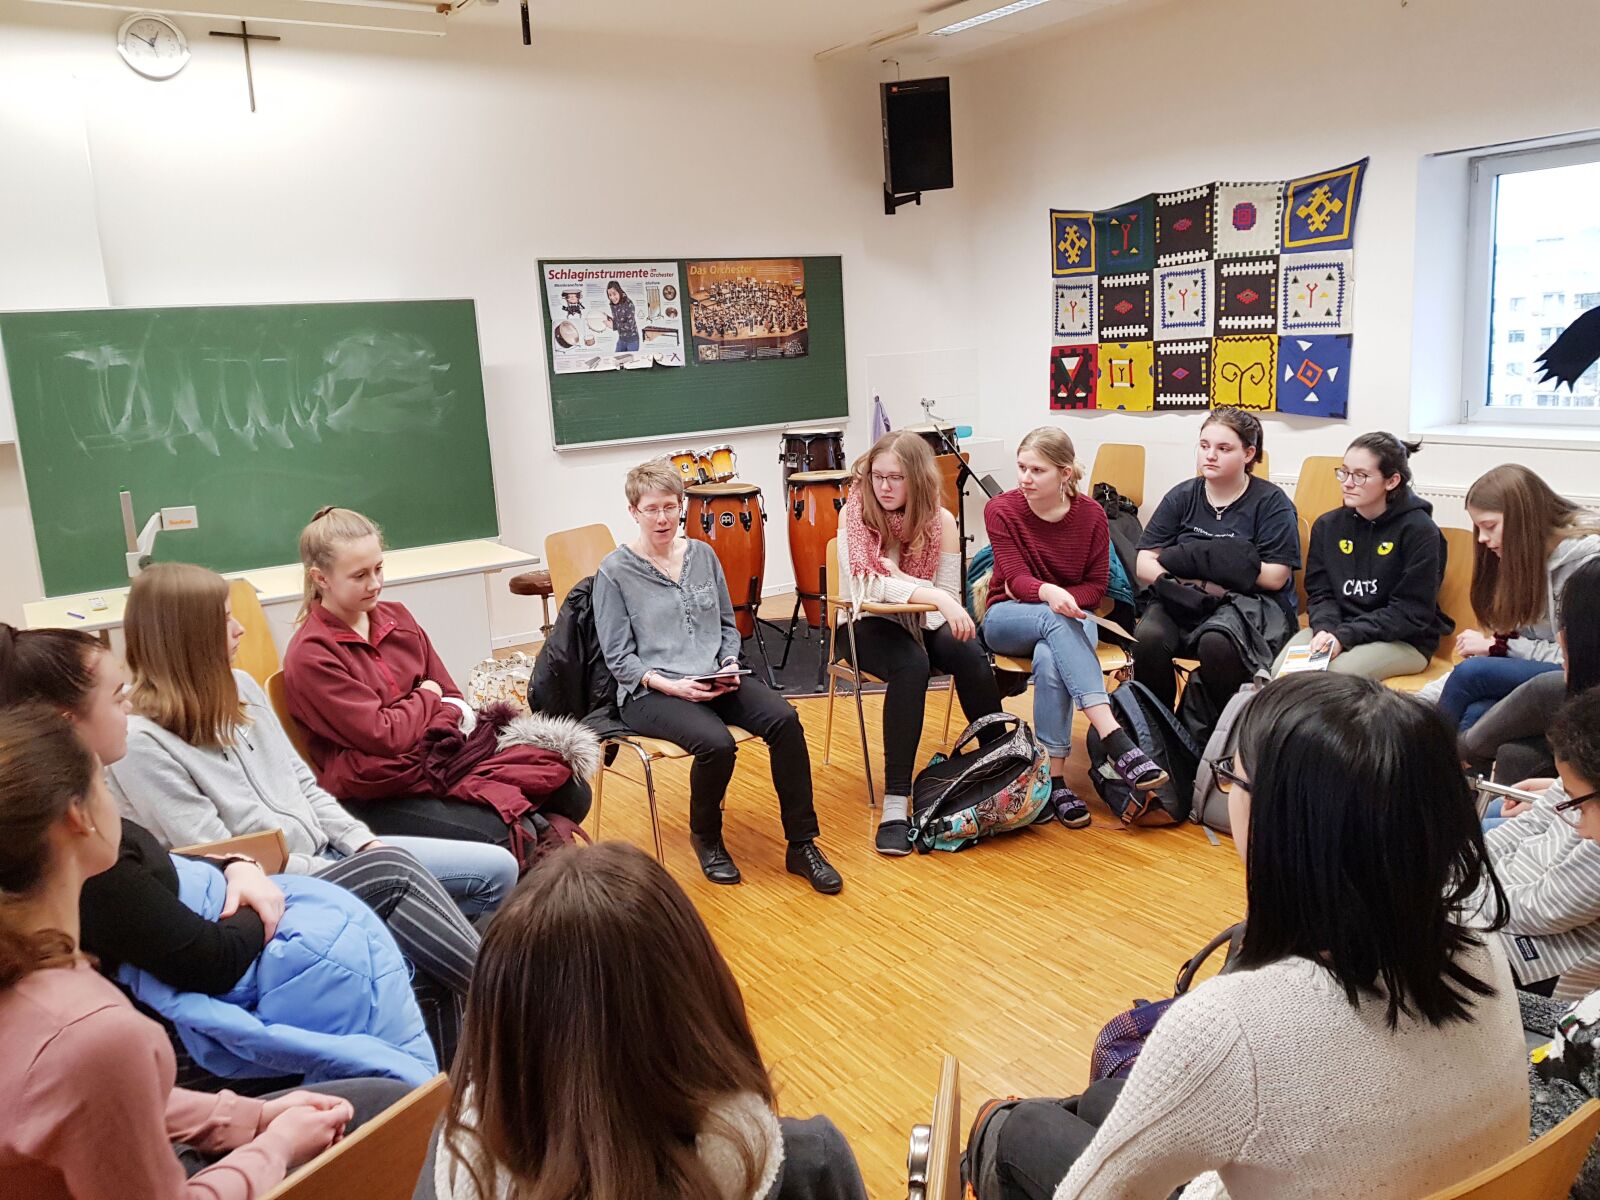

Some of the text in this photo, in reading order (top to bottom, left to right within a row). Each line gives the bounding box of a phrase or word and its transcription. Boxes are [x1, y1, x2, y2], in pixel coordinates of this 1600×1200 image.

[548, 268, 649, 282] Schlaginstrumente
[690, 265, 707, 275] Das
[709, 264, 753, 275] Orchester
[1343, 579, 1378, 597] CATS
